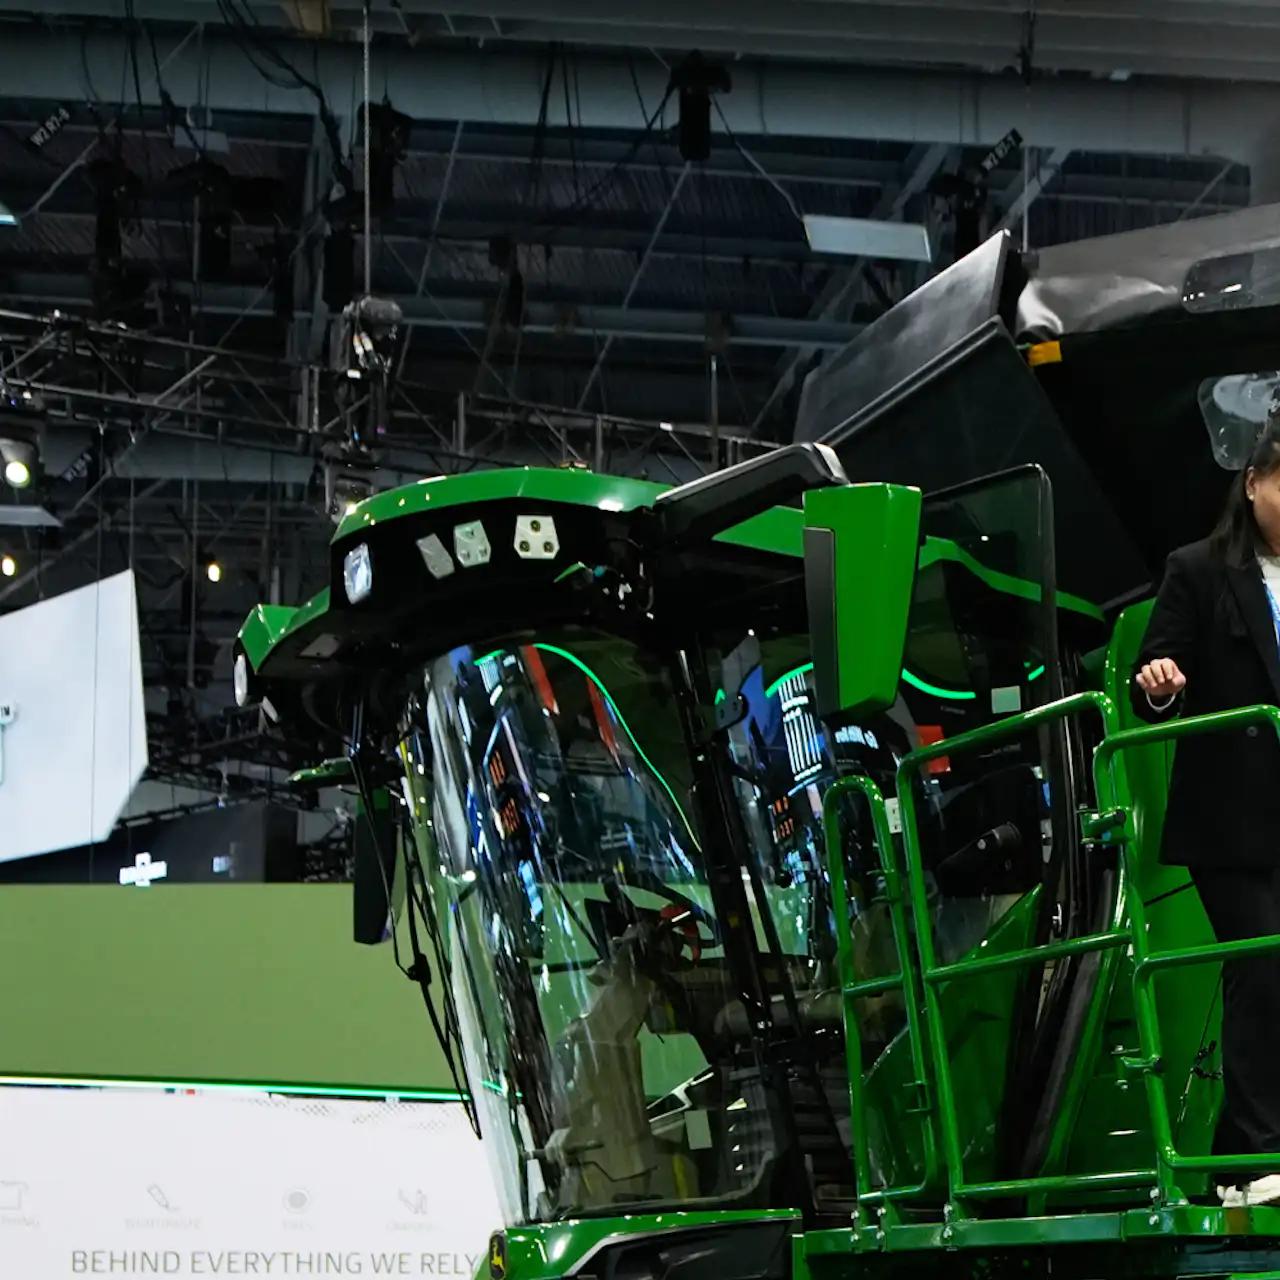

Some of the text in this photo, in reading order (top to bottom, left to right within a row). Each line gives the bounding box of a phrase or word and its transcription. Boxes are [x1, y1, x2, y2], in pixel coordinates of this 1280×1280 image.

[72, 1250, 480, 1276] BEHIND EVERYTHING WE RELY
